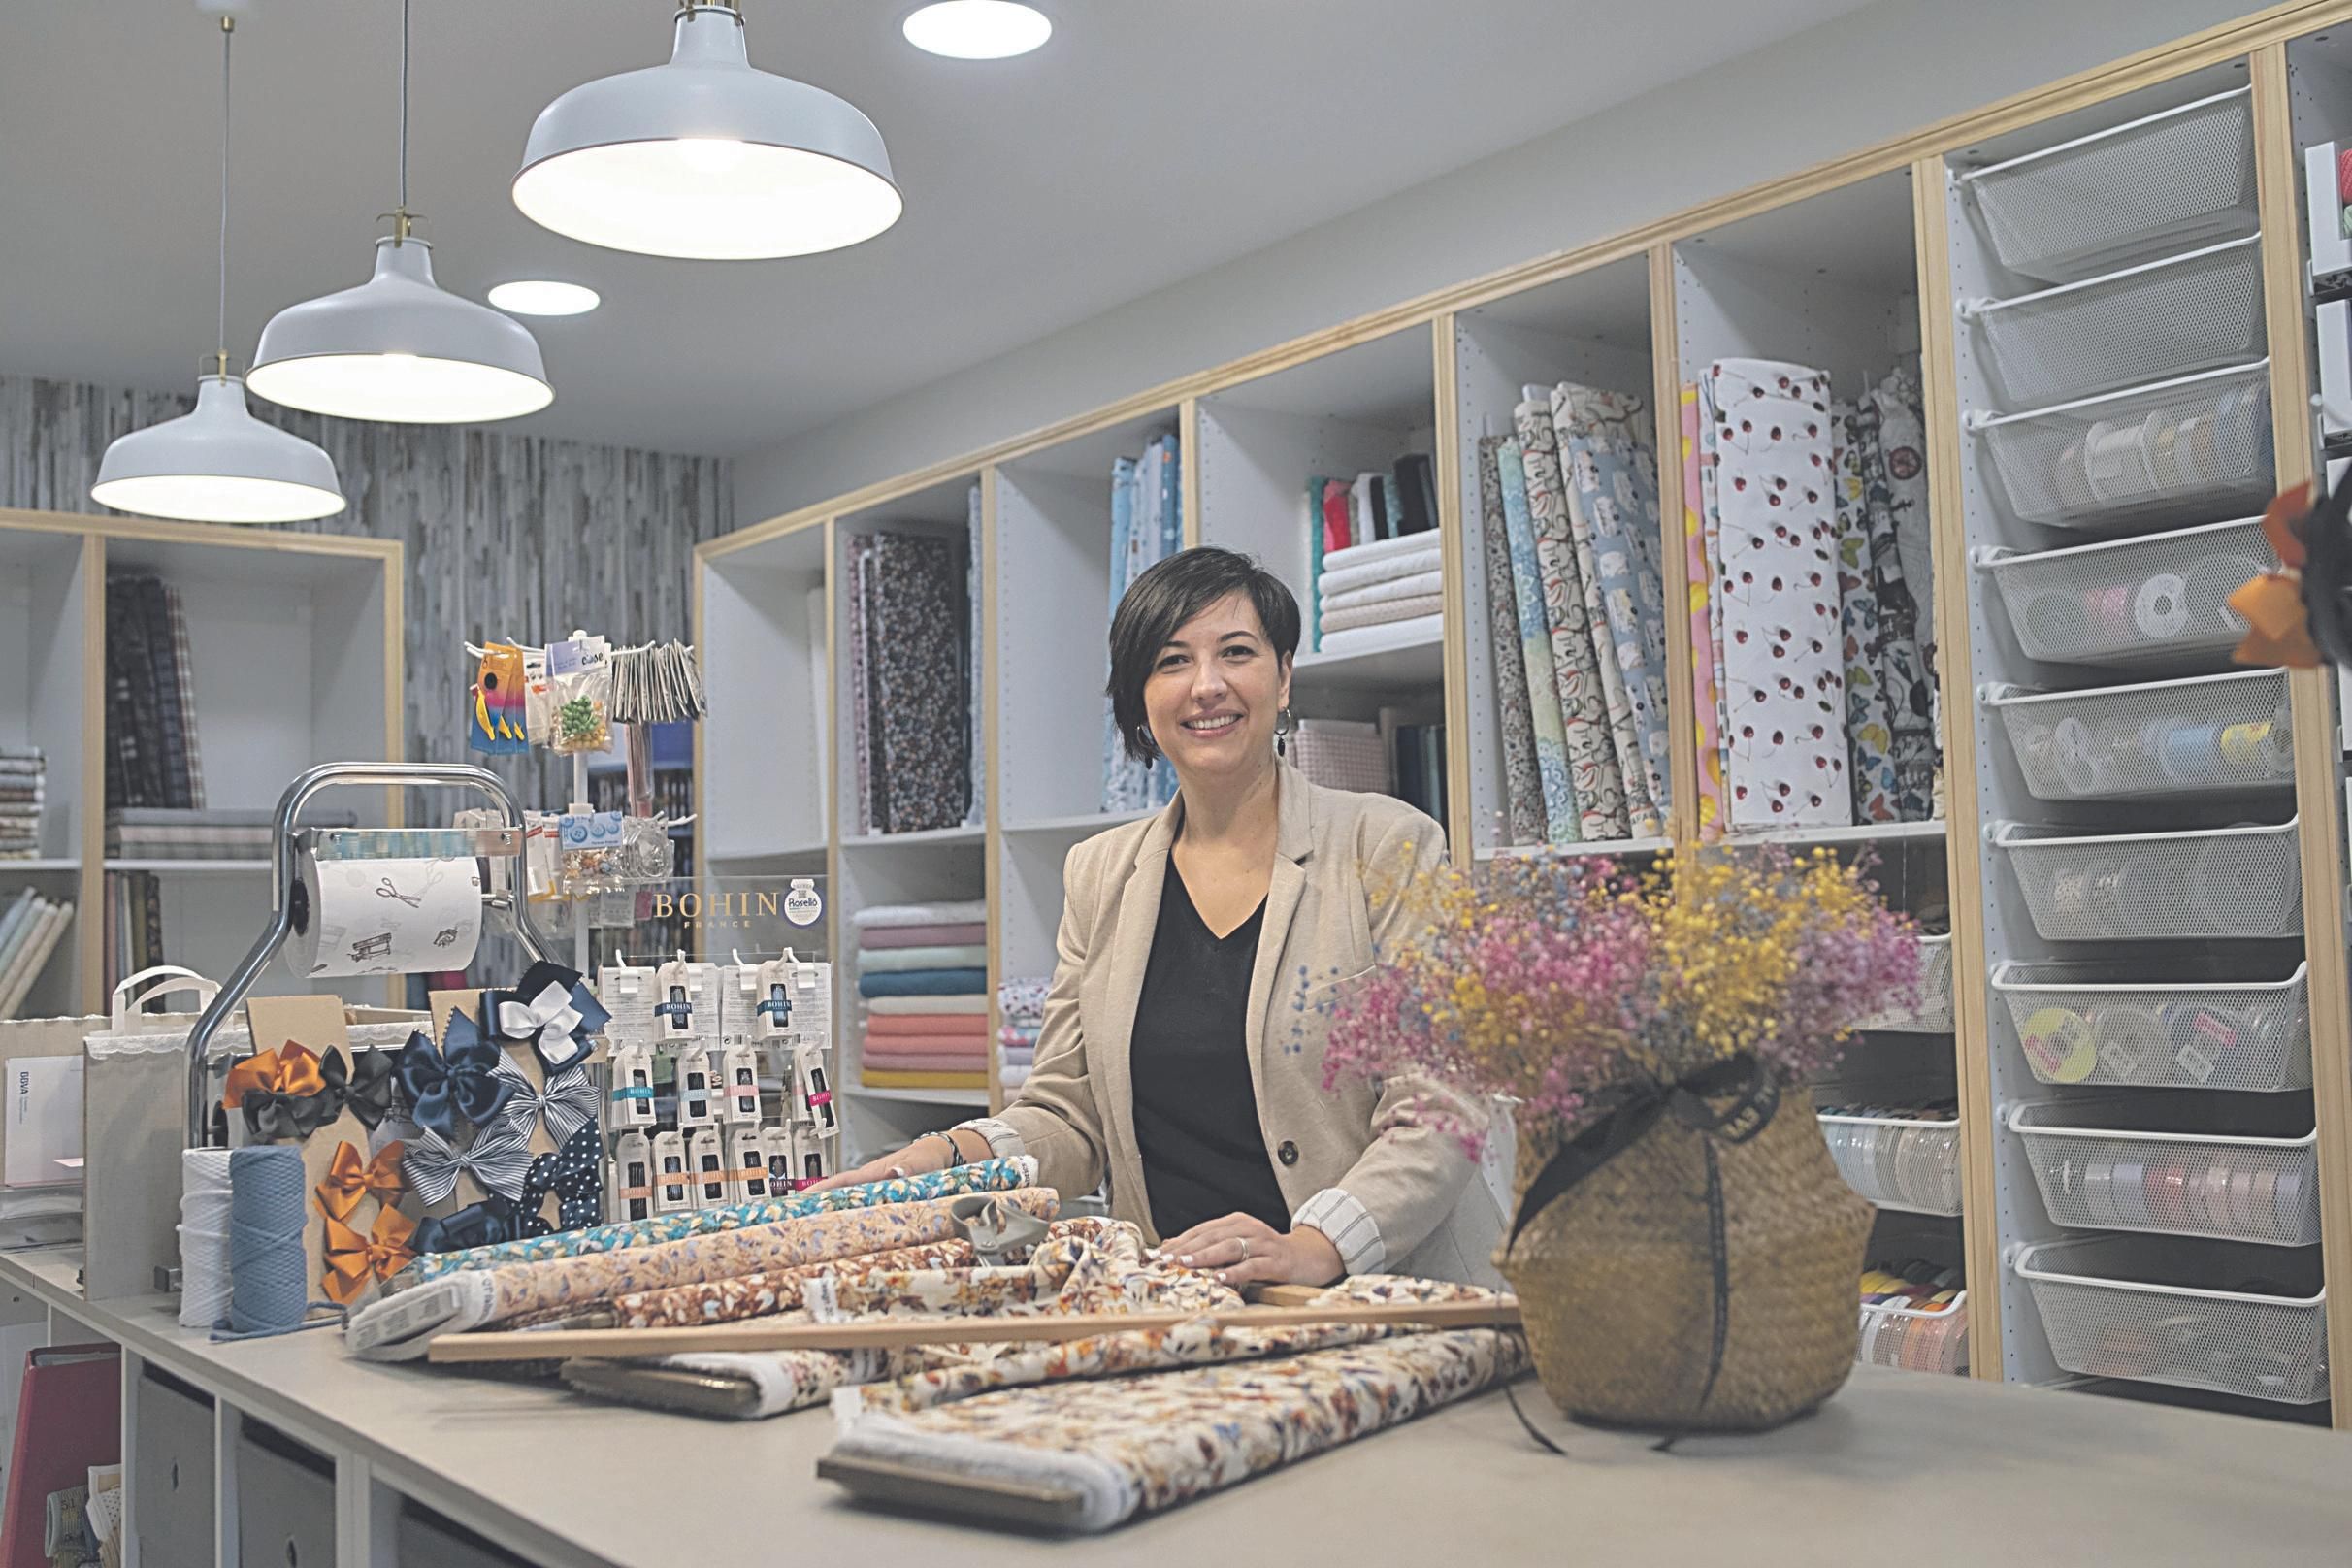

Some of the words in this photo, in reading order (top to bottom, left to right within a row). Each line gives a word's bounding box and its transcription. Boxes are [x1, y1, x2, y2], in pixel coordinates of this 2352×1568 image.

[653, 892, 779, 918] BOHIN
[683, 920, 752, 930] FRANCE
[19, 1071, 30, 1095] BBVA
